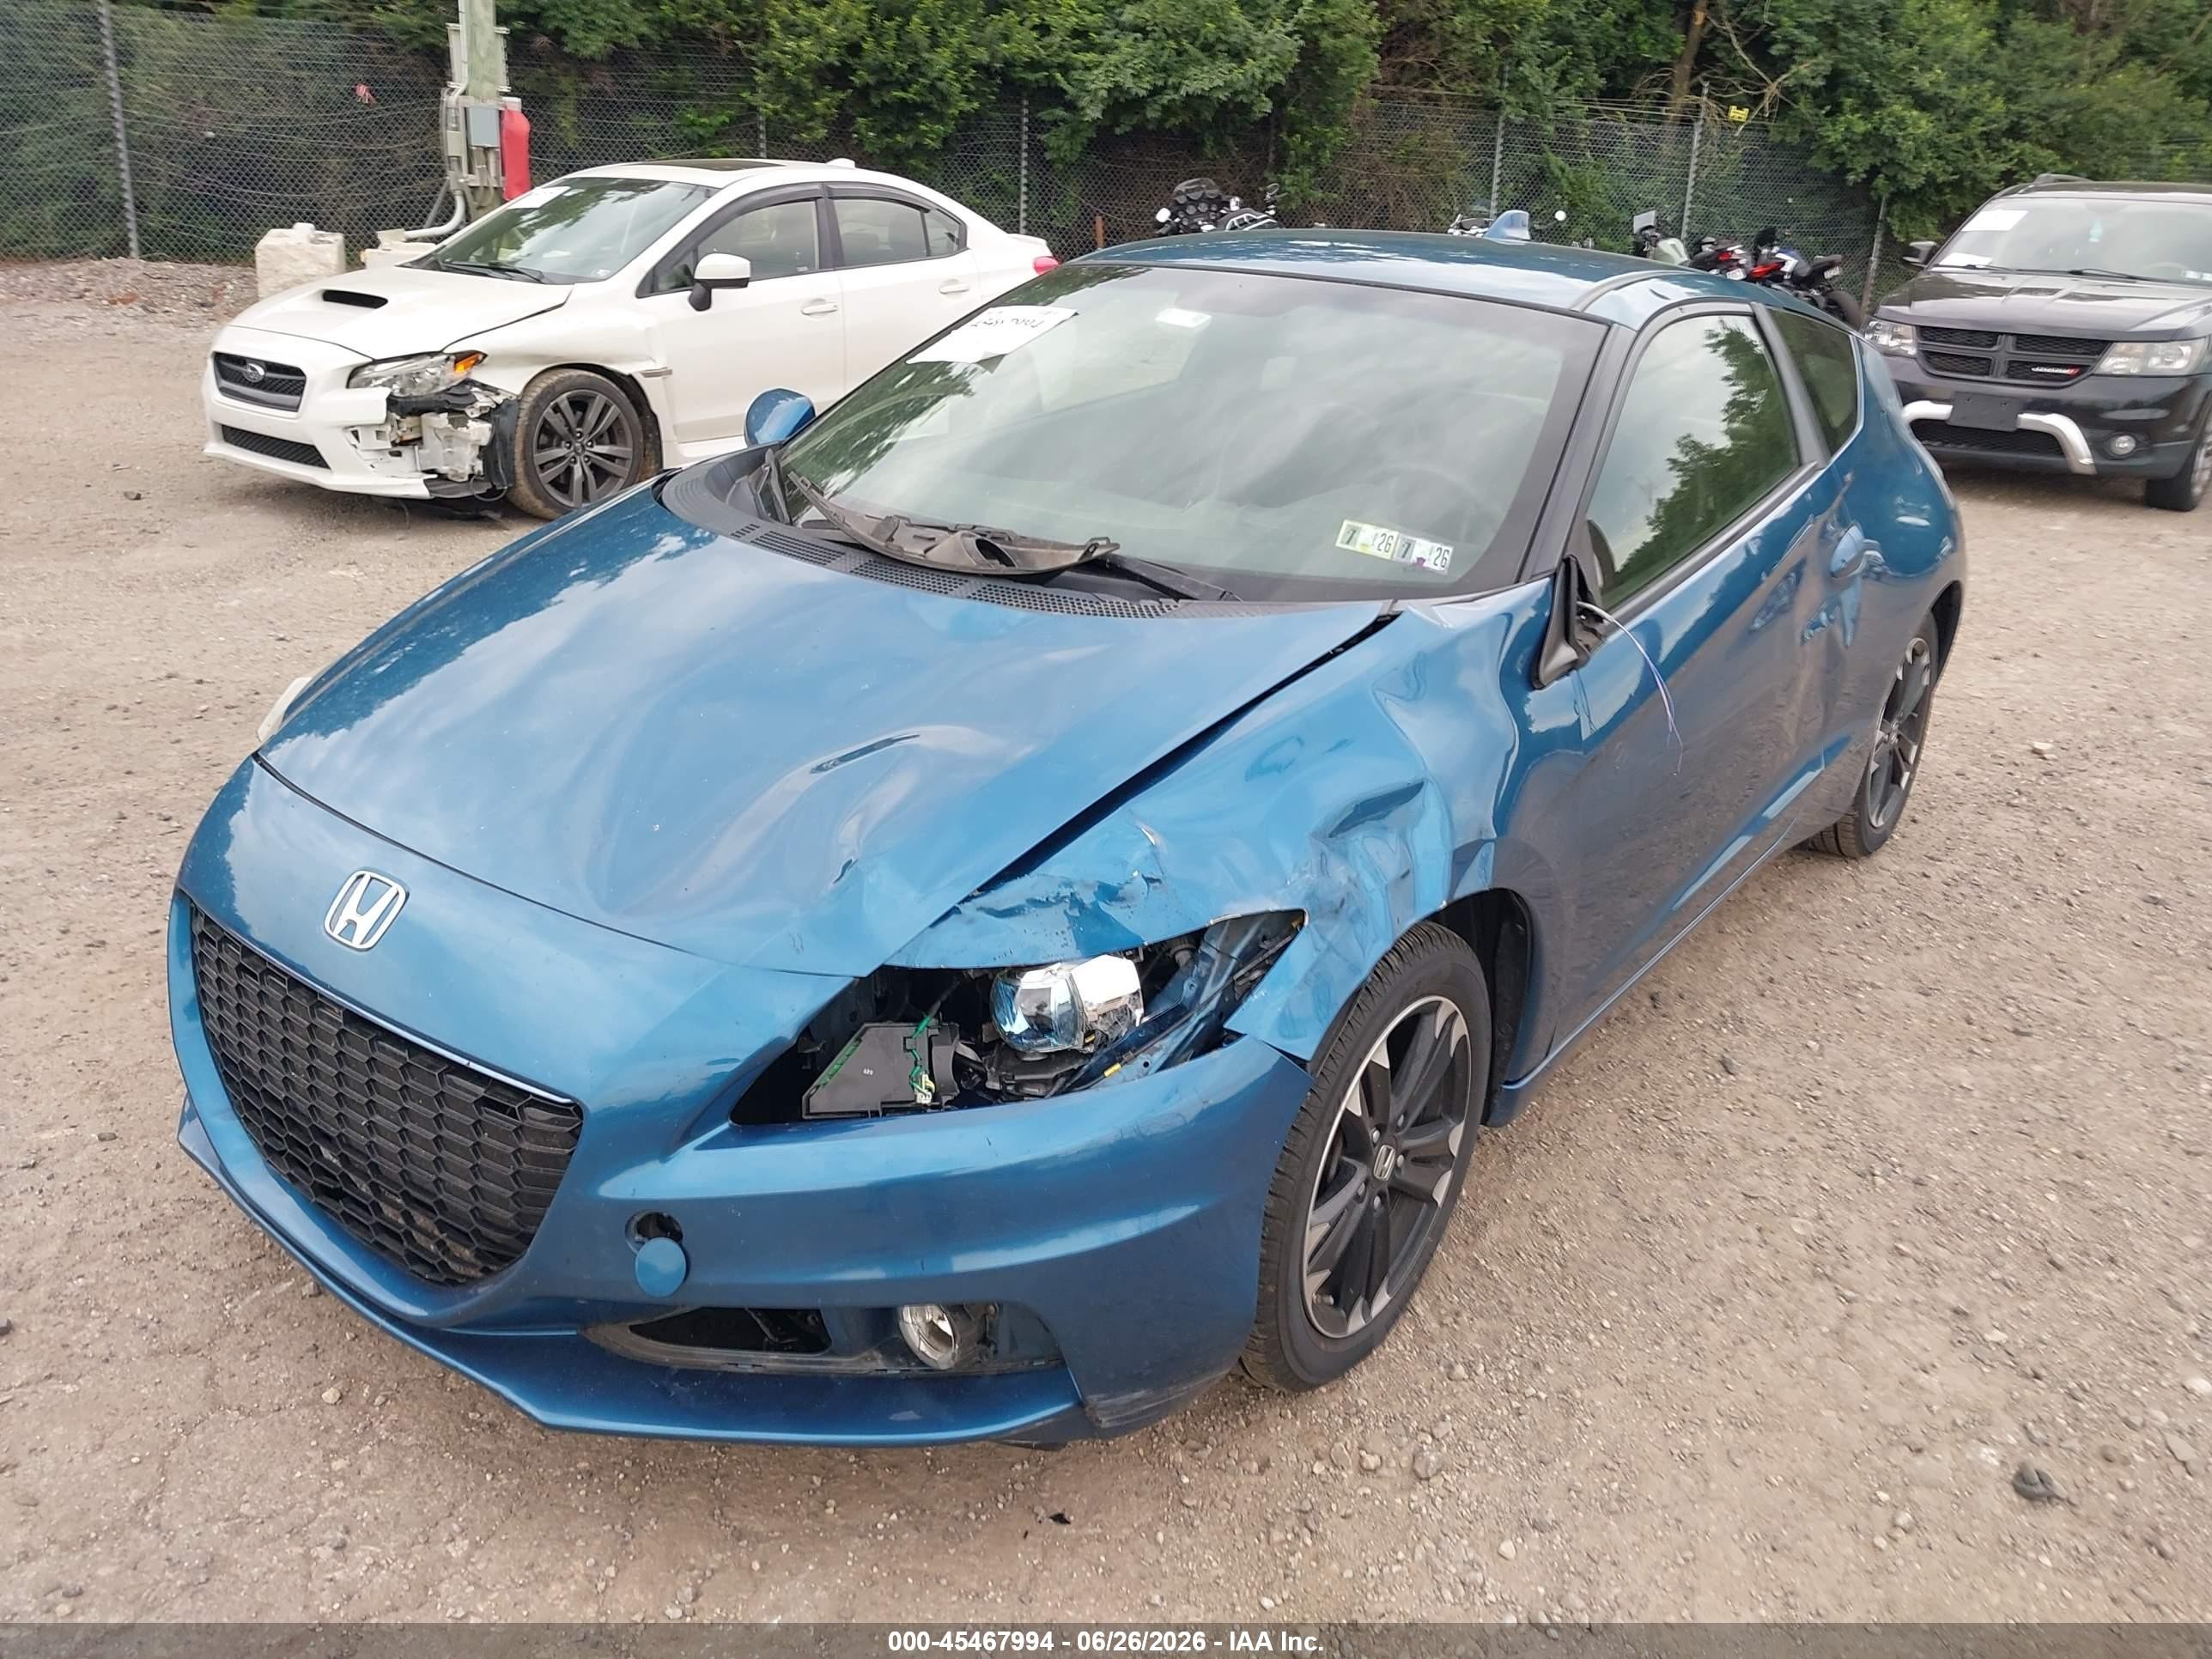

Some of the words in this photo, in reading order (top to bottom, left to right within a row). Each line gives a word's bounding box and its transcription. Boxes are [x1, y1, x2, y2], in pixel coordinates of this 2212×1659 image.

[1346, 529, 1357, 544] 7
[1376, 532, 1394, 553] 26
[1401, 541, 1411, 558] 7
[1433, 547, 1449, 568] 26
